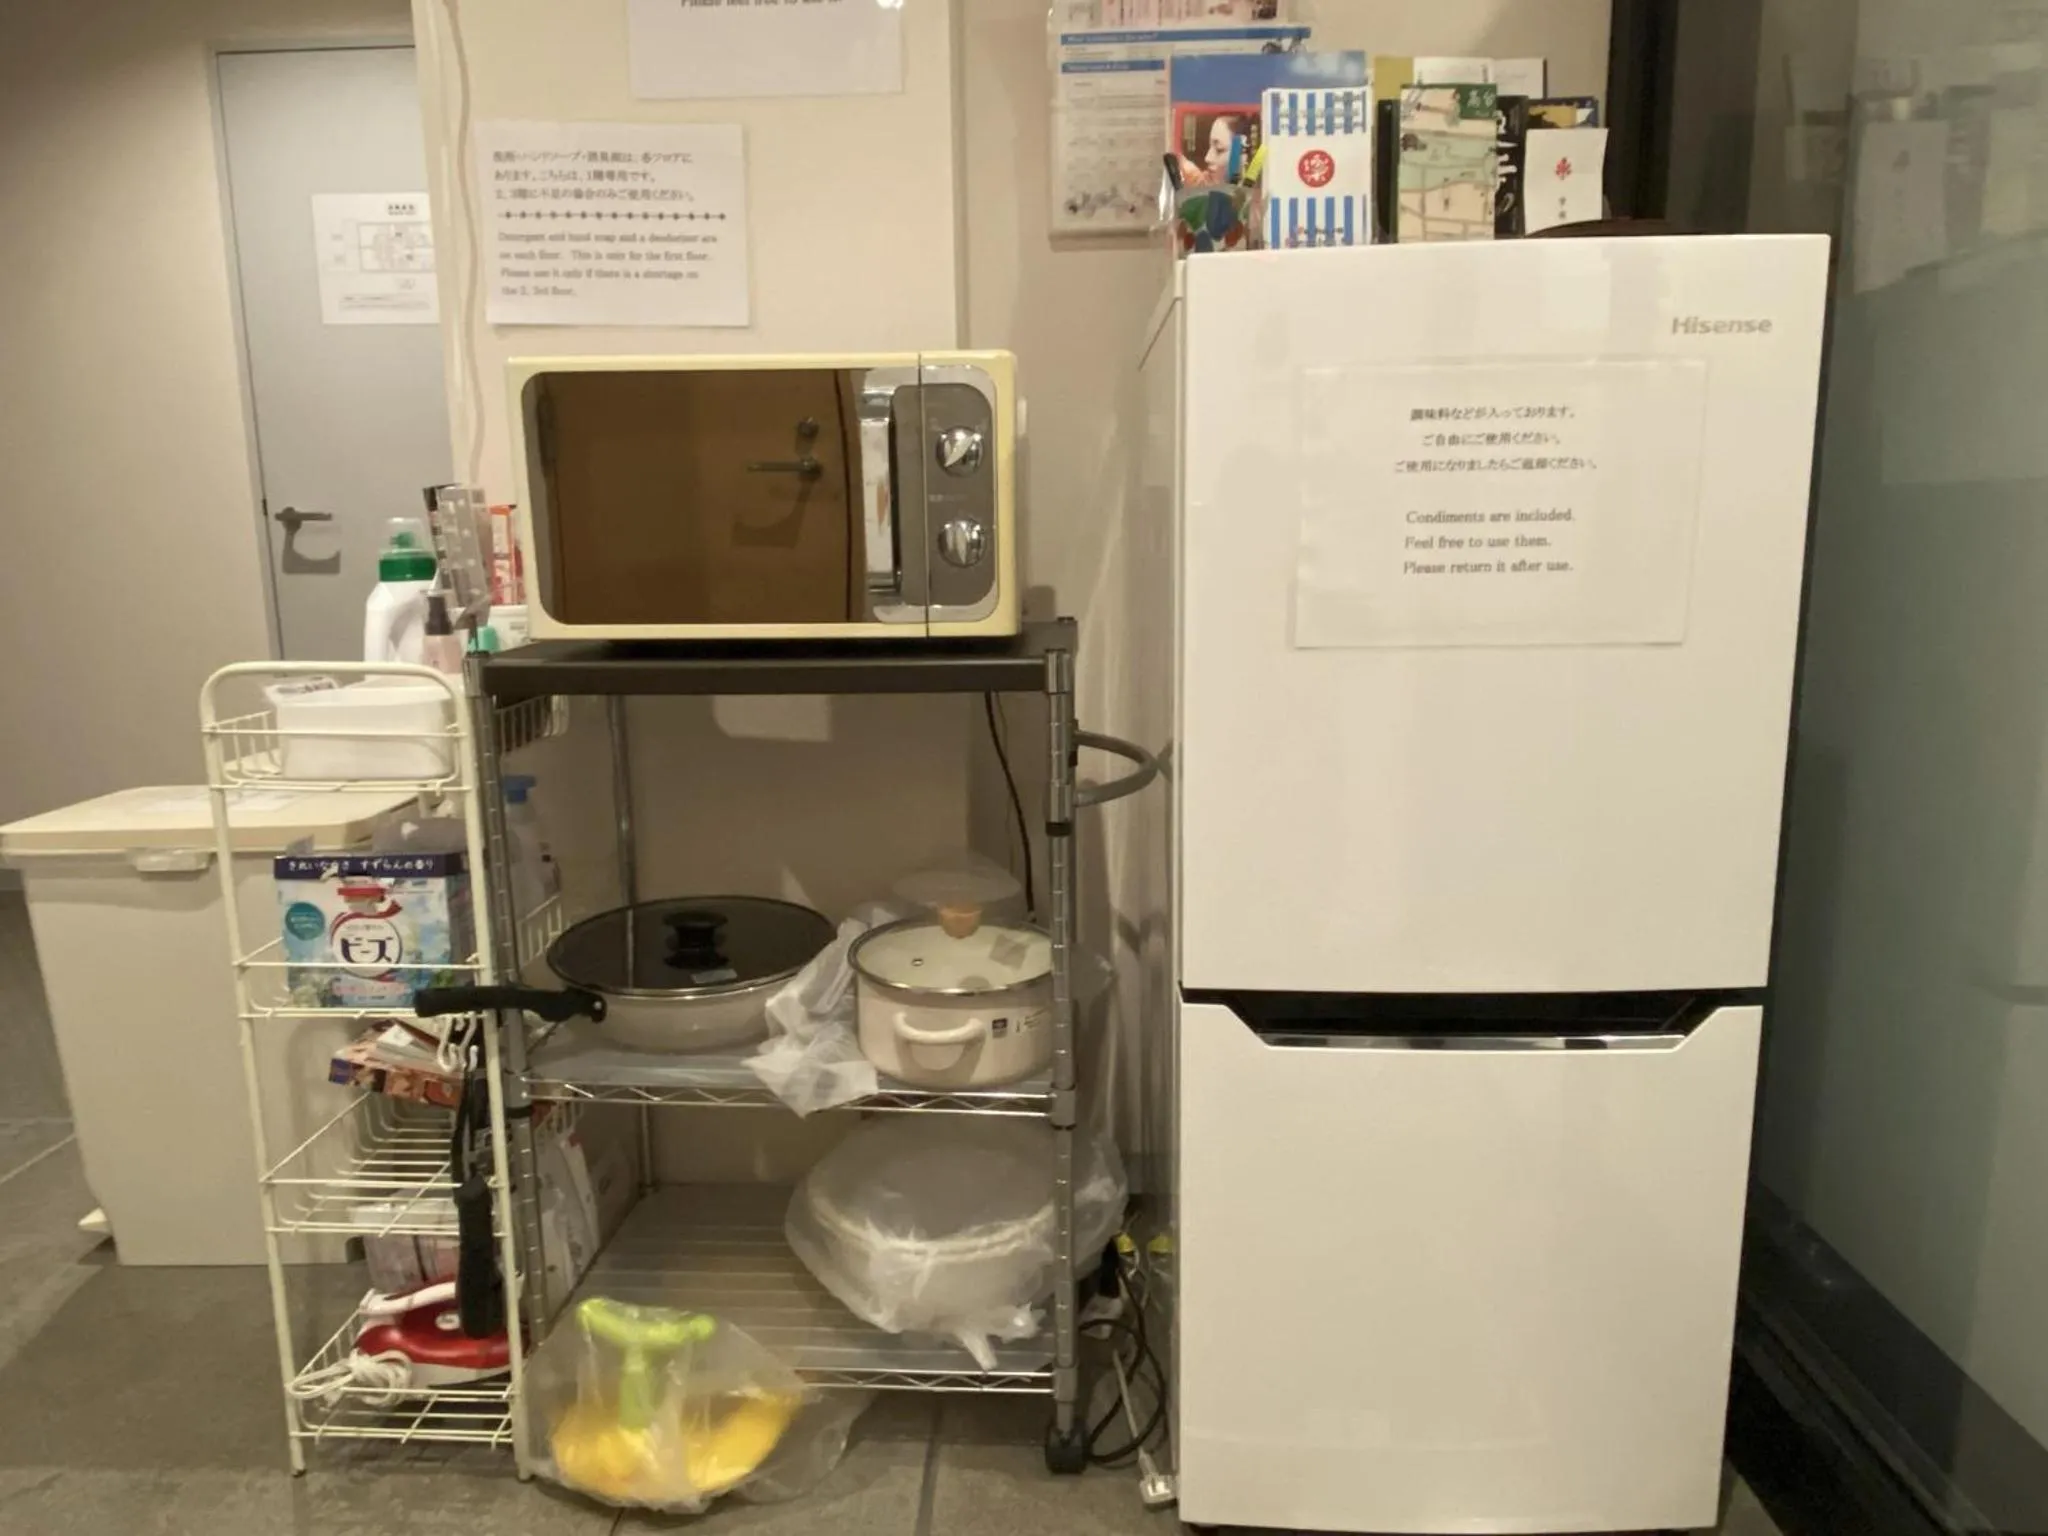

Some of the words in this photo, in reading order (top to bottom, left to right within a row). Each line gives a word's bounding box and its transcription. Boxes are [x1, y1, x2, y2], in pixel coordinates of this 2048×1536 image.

[619, 233, 637, 242] and
[571, 250, 592, 259] This
[645, 251, 661, 260] the
[664, 251, 683, 260] first
[501, 268, 530, 278] Please
[1671, 315, 1773, 335] Hisense
[1410, 406, 1576, 422] 調味料などが入っております。
[1422, 432, 1562, 447] ご自由にご使用ください。
[1406, 511, 1485, 524] Condiments
[1489, 514, 1512, 523] are
[1515, 508, 1576, 522] included.
[1404, 536, 1434, 549] Feel
[1438, 535, 1464, 548] free
[1468, 537, 1483, 548] to
[1487, 538, 1510, 547] use
[1514, 534, 1552, 547] them.
[1403, 561, 1446, 574] Please
[1449, 562, 1493, 573] return
[1496, 560, 1506, 572] it
[1510, 559, 1542, 572] after
[1546, 561, 1574, 571] use.
[360, 858, 434, 871] すずらんの香り
